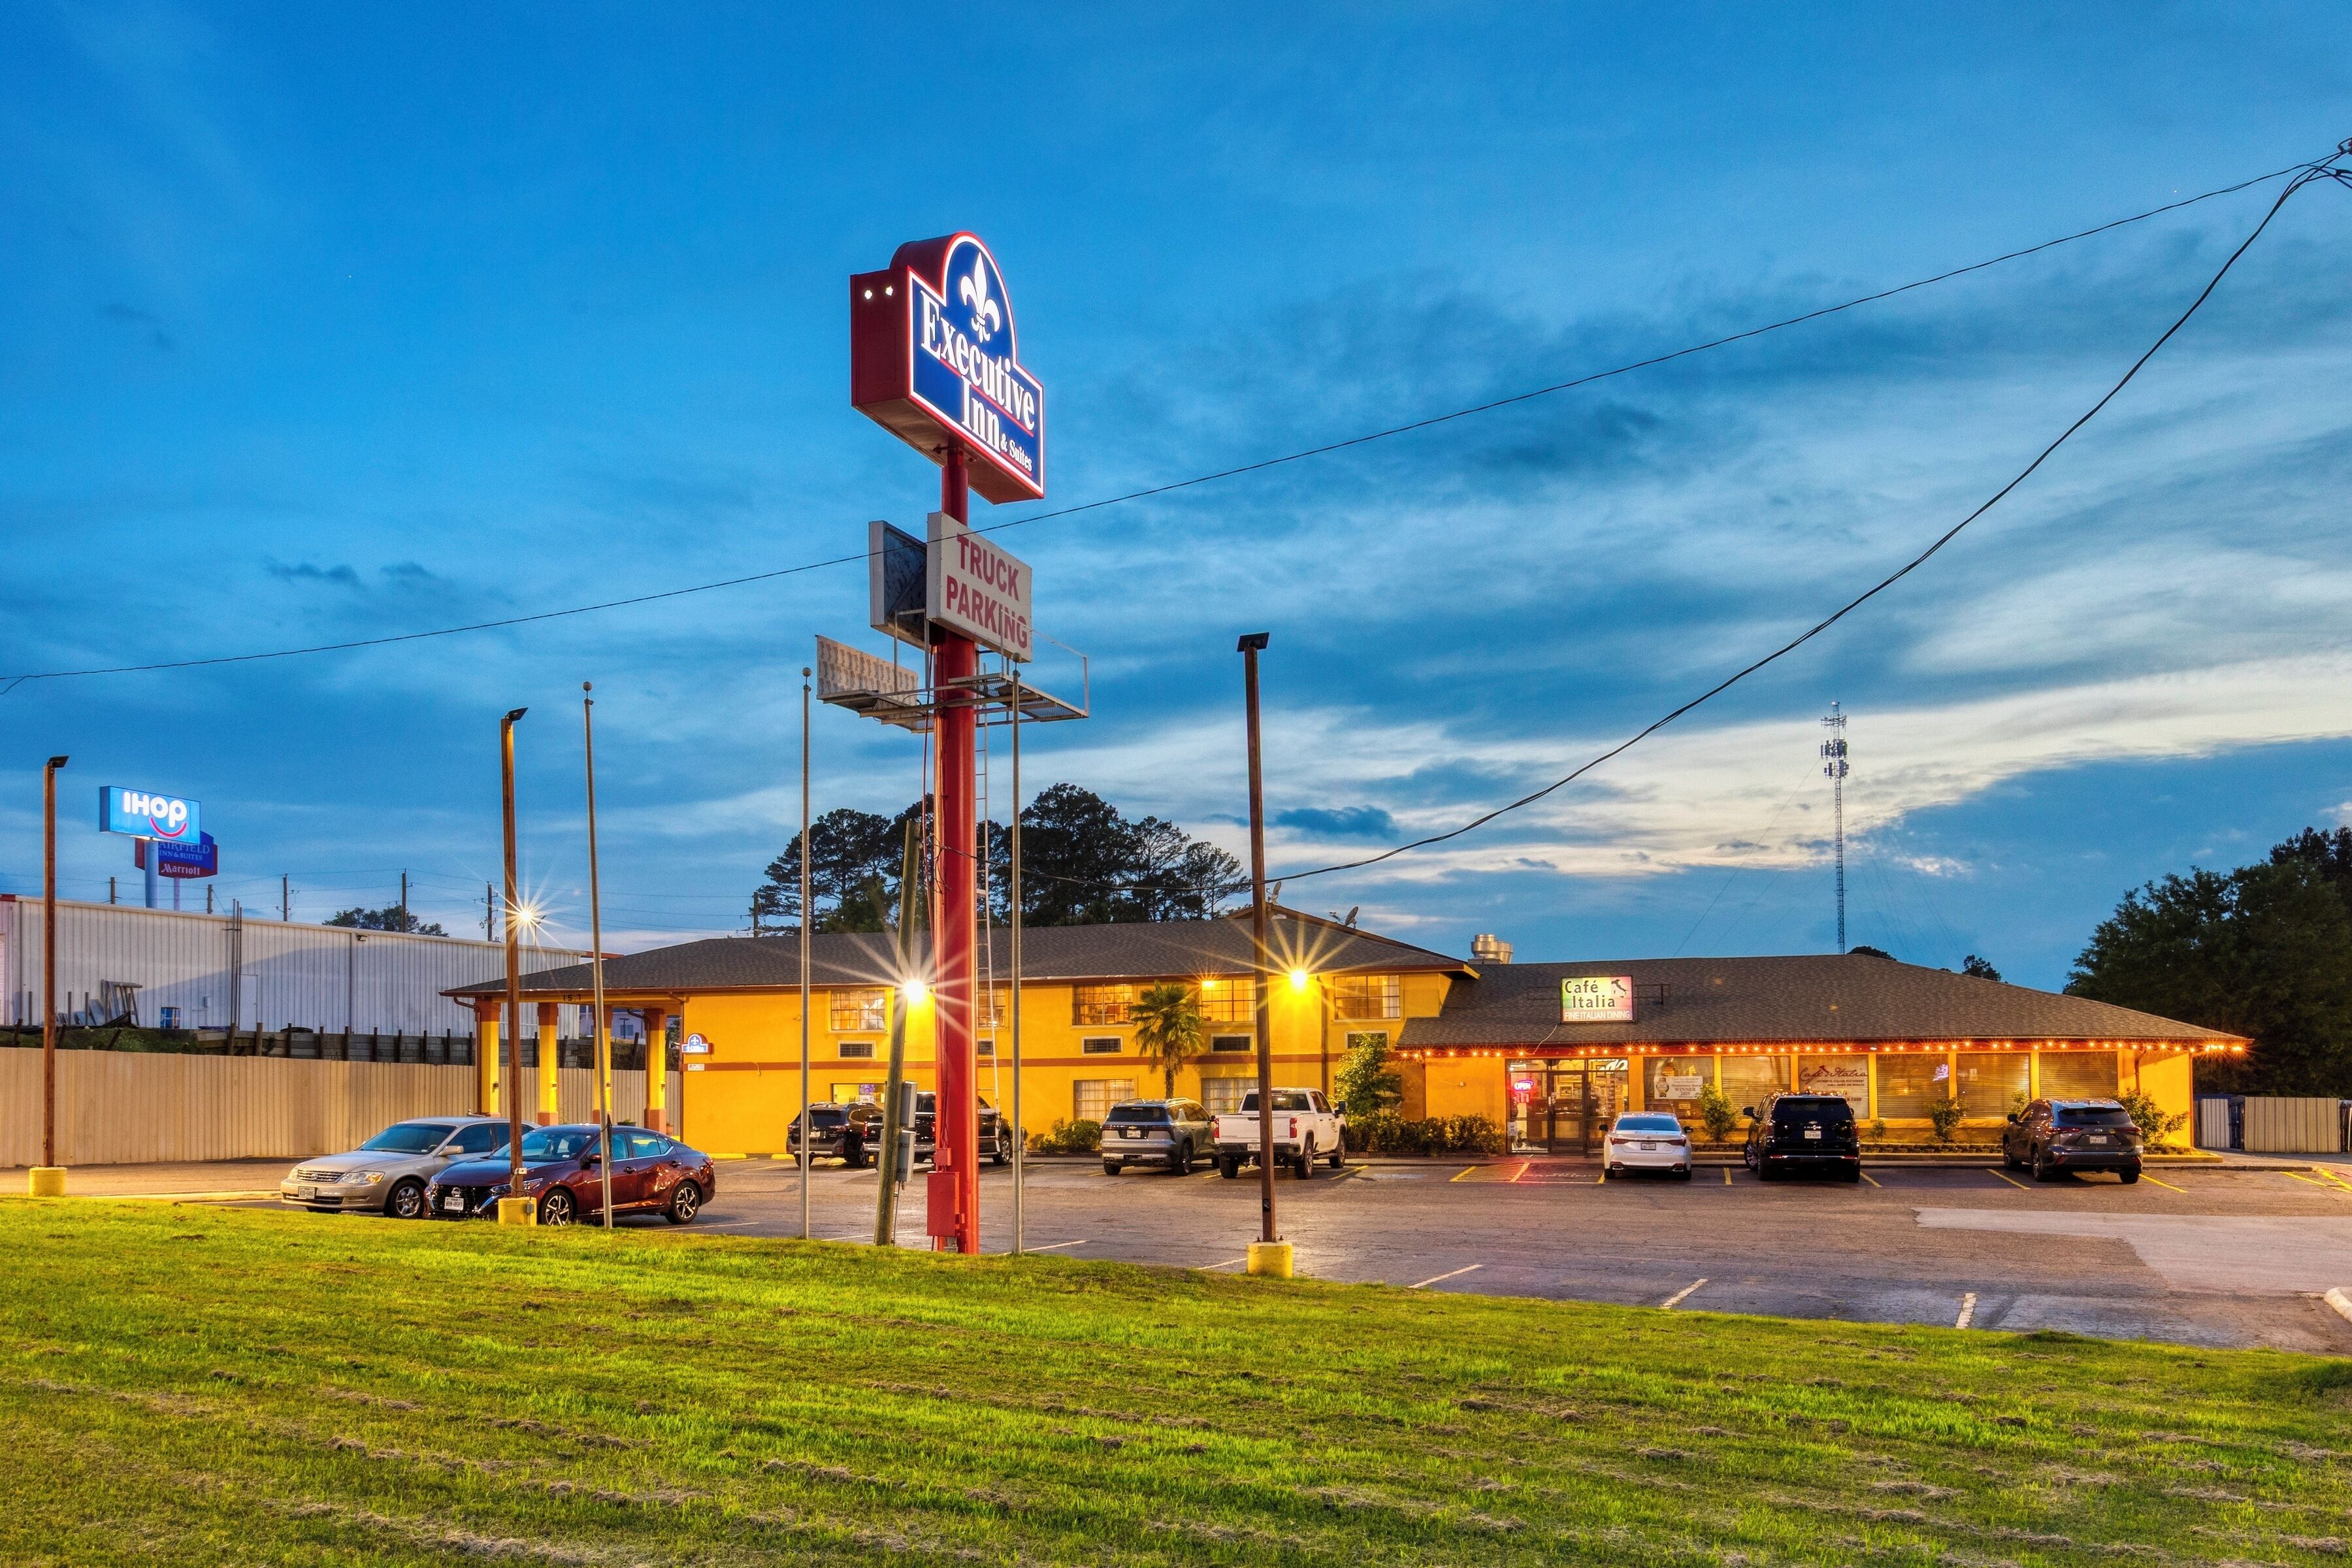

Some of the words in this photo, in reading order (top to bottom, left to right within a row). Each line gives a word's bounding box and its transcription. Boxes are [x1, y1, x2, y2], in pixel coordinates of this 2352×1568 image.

[921, 290, 1035, 431] Executive
[961, 376, 1001, 454] Inn
[1001, 435, 1007, 453] &
[1009, 439, 1033, 472] Suites
[956, 532, 1020, 602] TRUCK
[946, 575, 1028, 649] PARKING
[159, 841, 210, 855] AIRFIELD
[180, 852, 203, 860] SUITES
[161, 863, 200, 875] Marriott
[1565, 980, 1599, 994] Café
[1573, 995, 1616, 1008] Italia
[1565, 1011, 1580, 1020] FINE
[1580, 1011, 1606, 1020] ITALIAN
[1607, 1010, 1630, 1019] DINING
[1800, 1068, 1823, 1085] Café
[1830, 1067, 1868, 1077] Italia
[1514, 1082, 1531, 1090] OPEN
